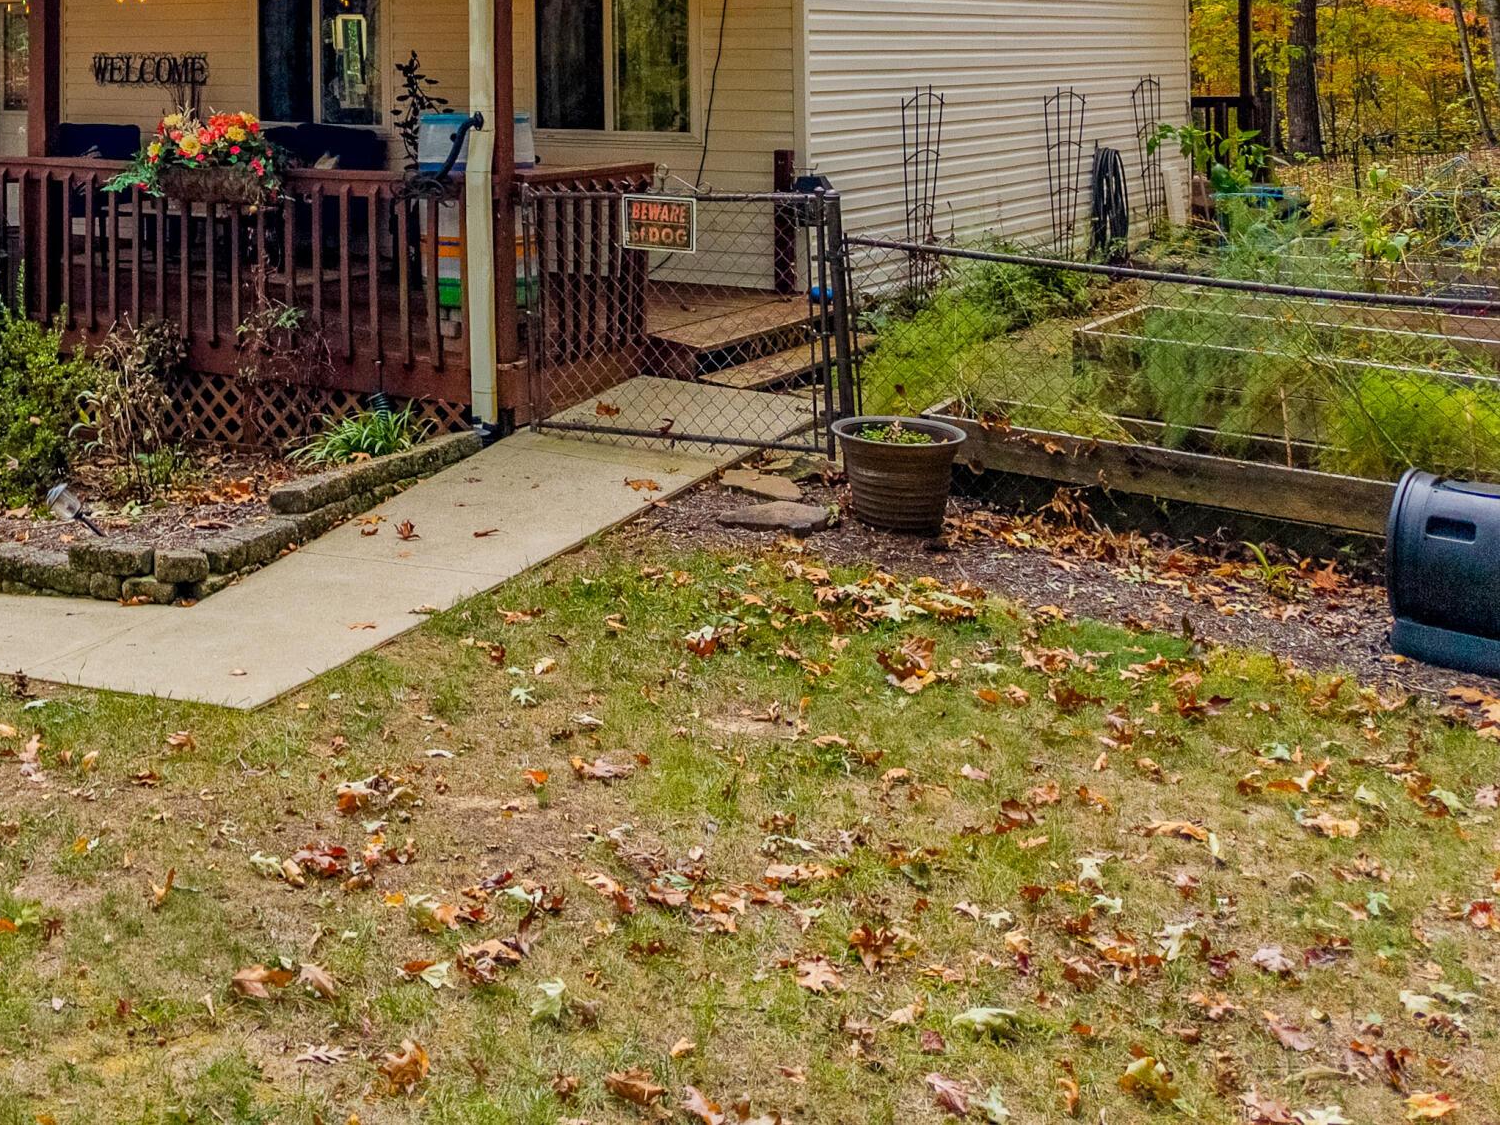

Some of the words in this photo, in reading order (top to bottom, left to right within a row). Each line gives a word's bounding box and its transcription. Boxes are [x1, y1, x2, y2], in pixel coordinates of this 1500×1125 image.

[91, 54, 209, 87] WELCOME
[631, 201, 686, 223] BEWARE
[631, 226, 646, 242] of
[648, 226, 688, 245] DOG
